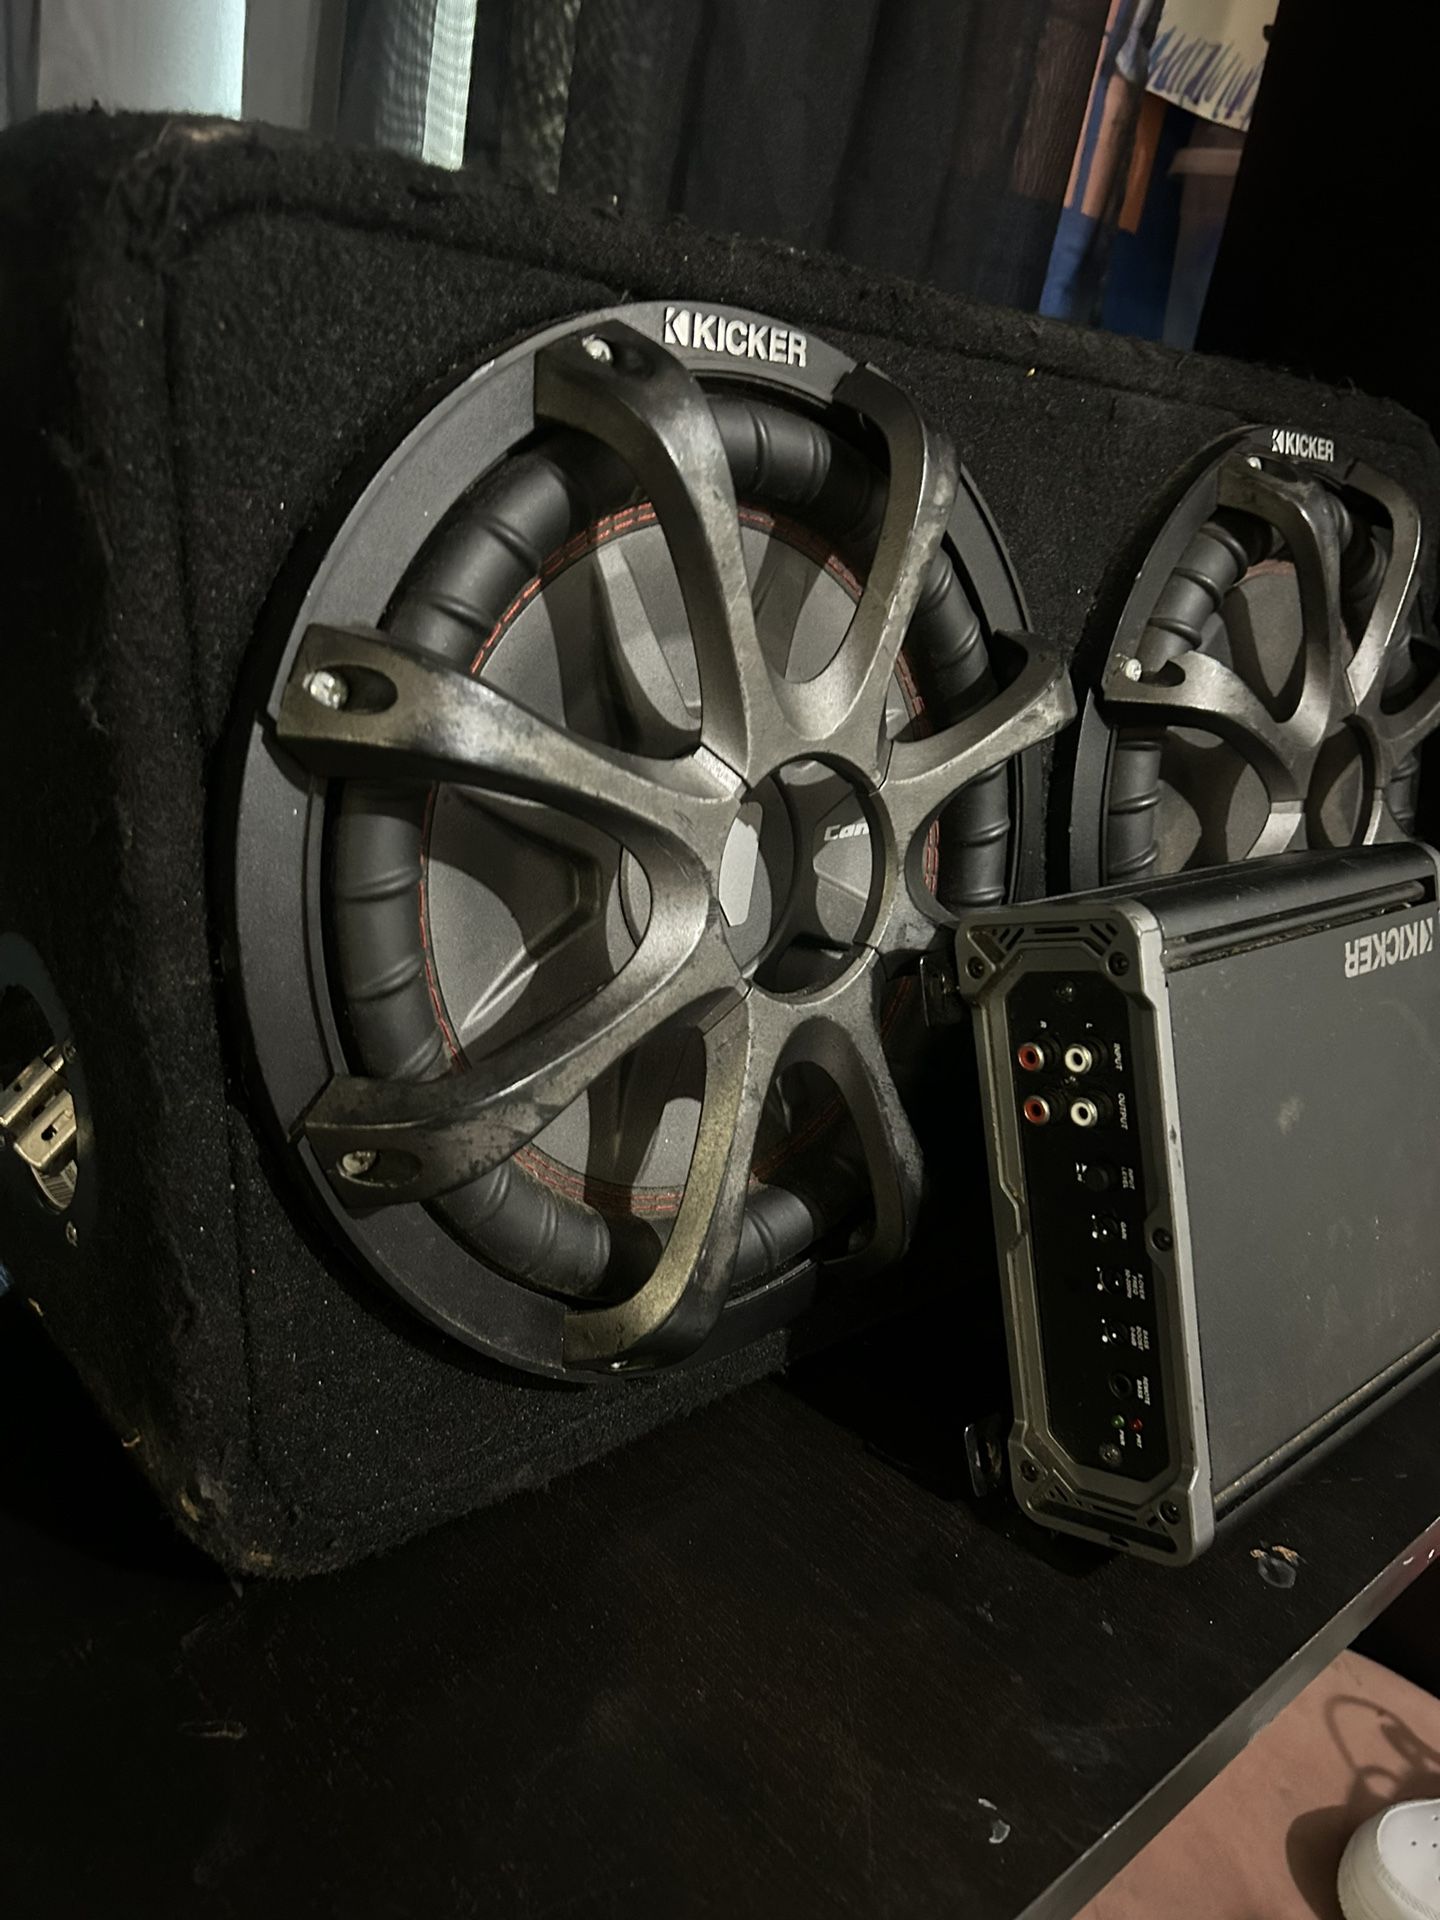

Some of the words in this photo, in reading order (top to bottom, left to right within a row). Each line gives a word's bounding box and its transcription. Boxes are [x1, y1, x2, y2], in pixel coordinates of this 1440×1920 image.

[692, 311, 807, 367] KICKER
[1285, 431, 1334, 462] KICKER
[1345, 920, 1419, 978] KICKER
[1113, 1042, 1123, 1072] INPUT
[1117, 1092, 1129, 1130] OUTPUT
